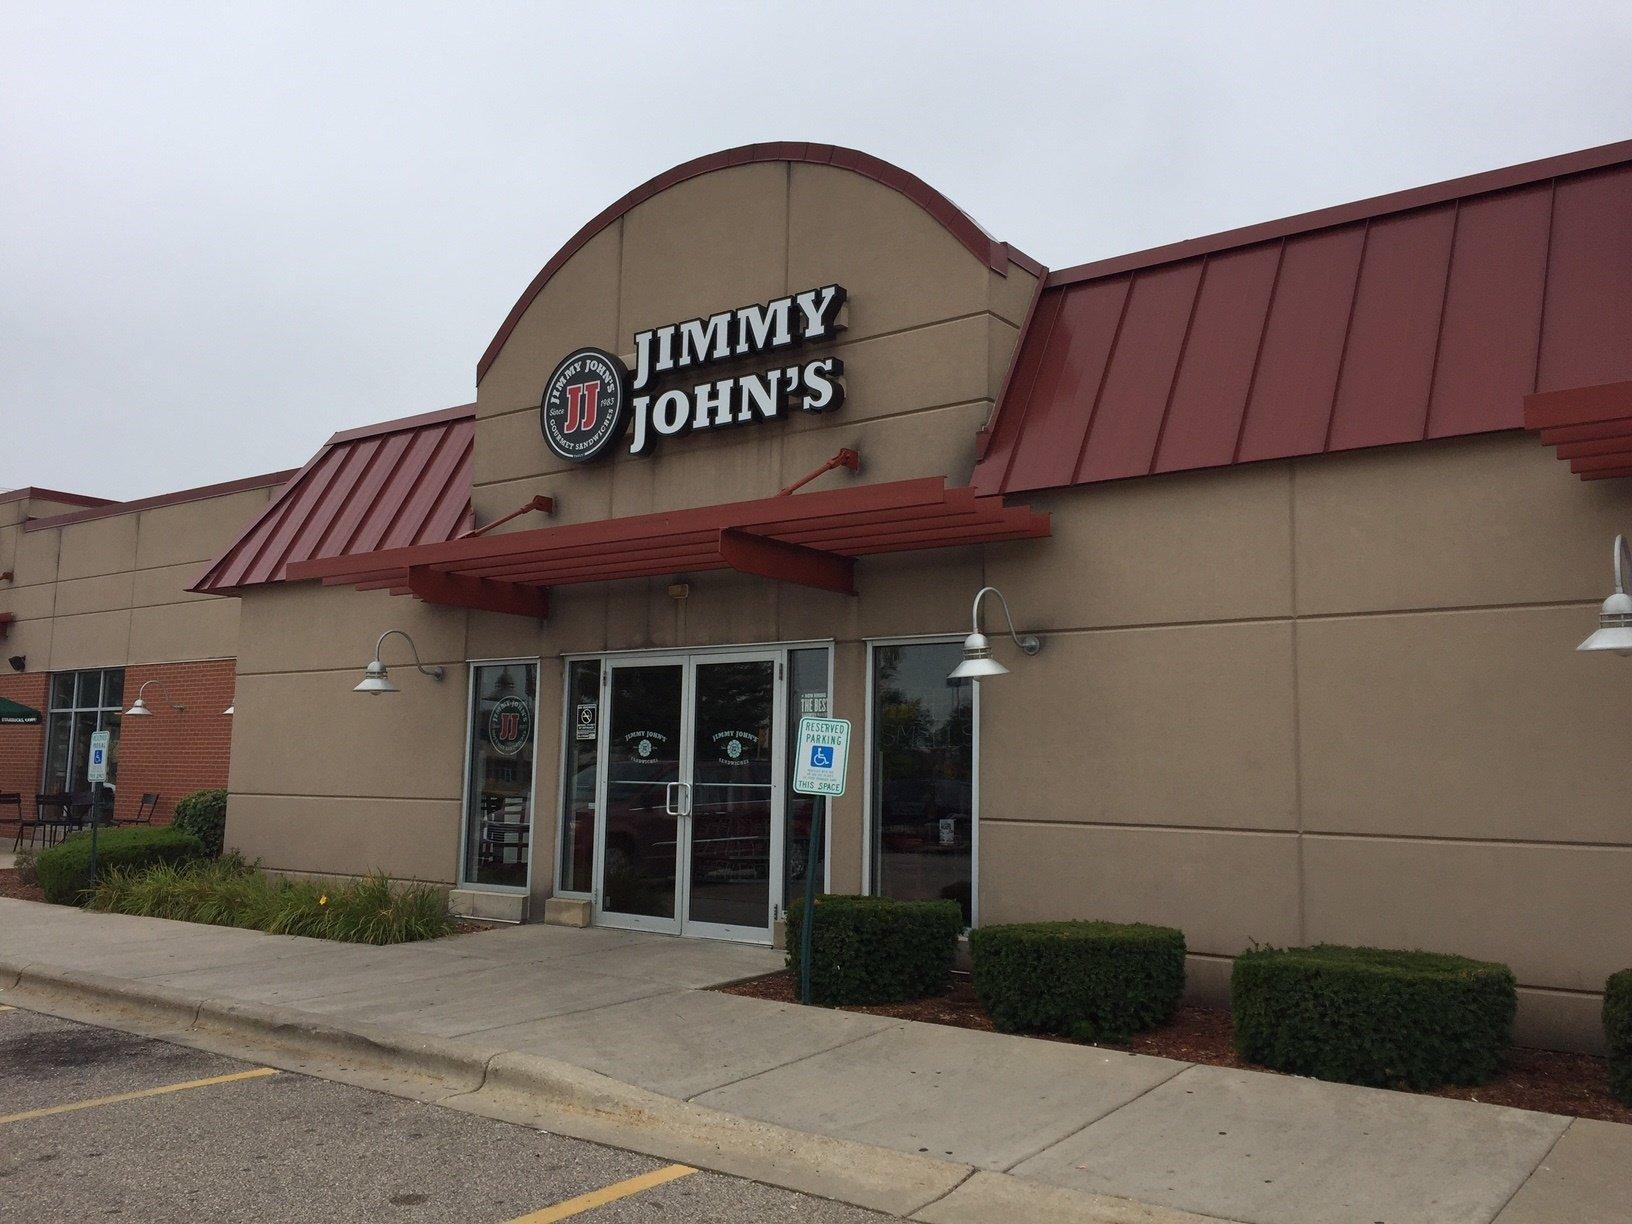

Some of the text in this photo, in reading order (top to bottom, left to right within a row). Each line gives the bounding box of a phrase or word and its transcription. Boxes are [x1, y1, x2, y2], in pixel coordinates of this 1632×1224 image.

[633, 286, 836, 390] JIMMY
[550, 360, 615, 405] JIMMY JOHN'S
[549, 408, 565, 416] Since
[563, 380, 601, 434] JJ
[629, 359, 834, 454] JOHN'S
[549, 408, 614, 450] GOURMET SANDWICHES
[801, 698, 828, 712] THE BES
[499, 713, 520, 740] JJ
[805, 722, 844, 734] RESERVED
[625, 731, 645, 741] JIMMY
[712, 731, 734, 742] JIMMY
[806, 734, 842, 746] PARKING
[798, 780, 840, 791] THIS SPACE
